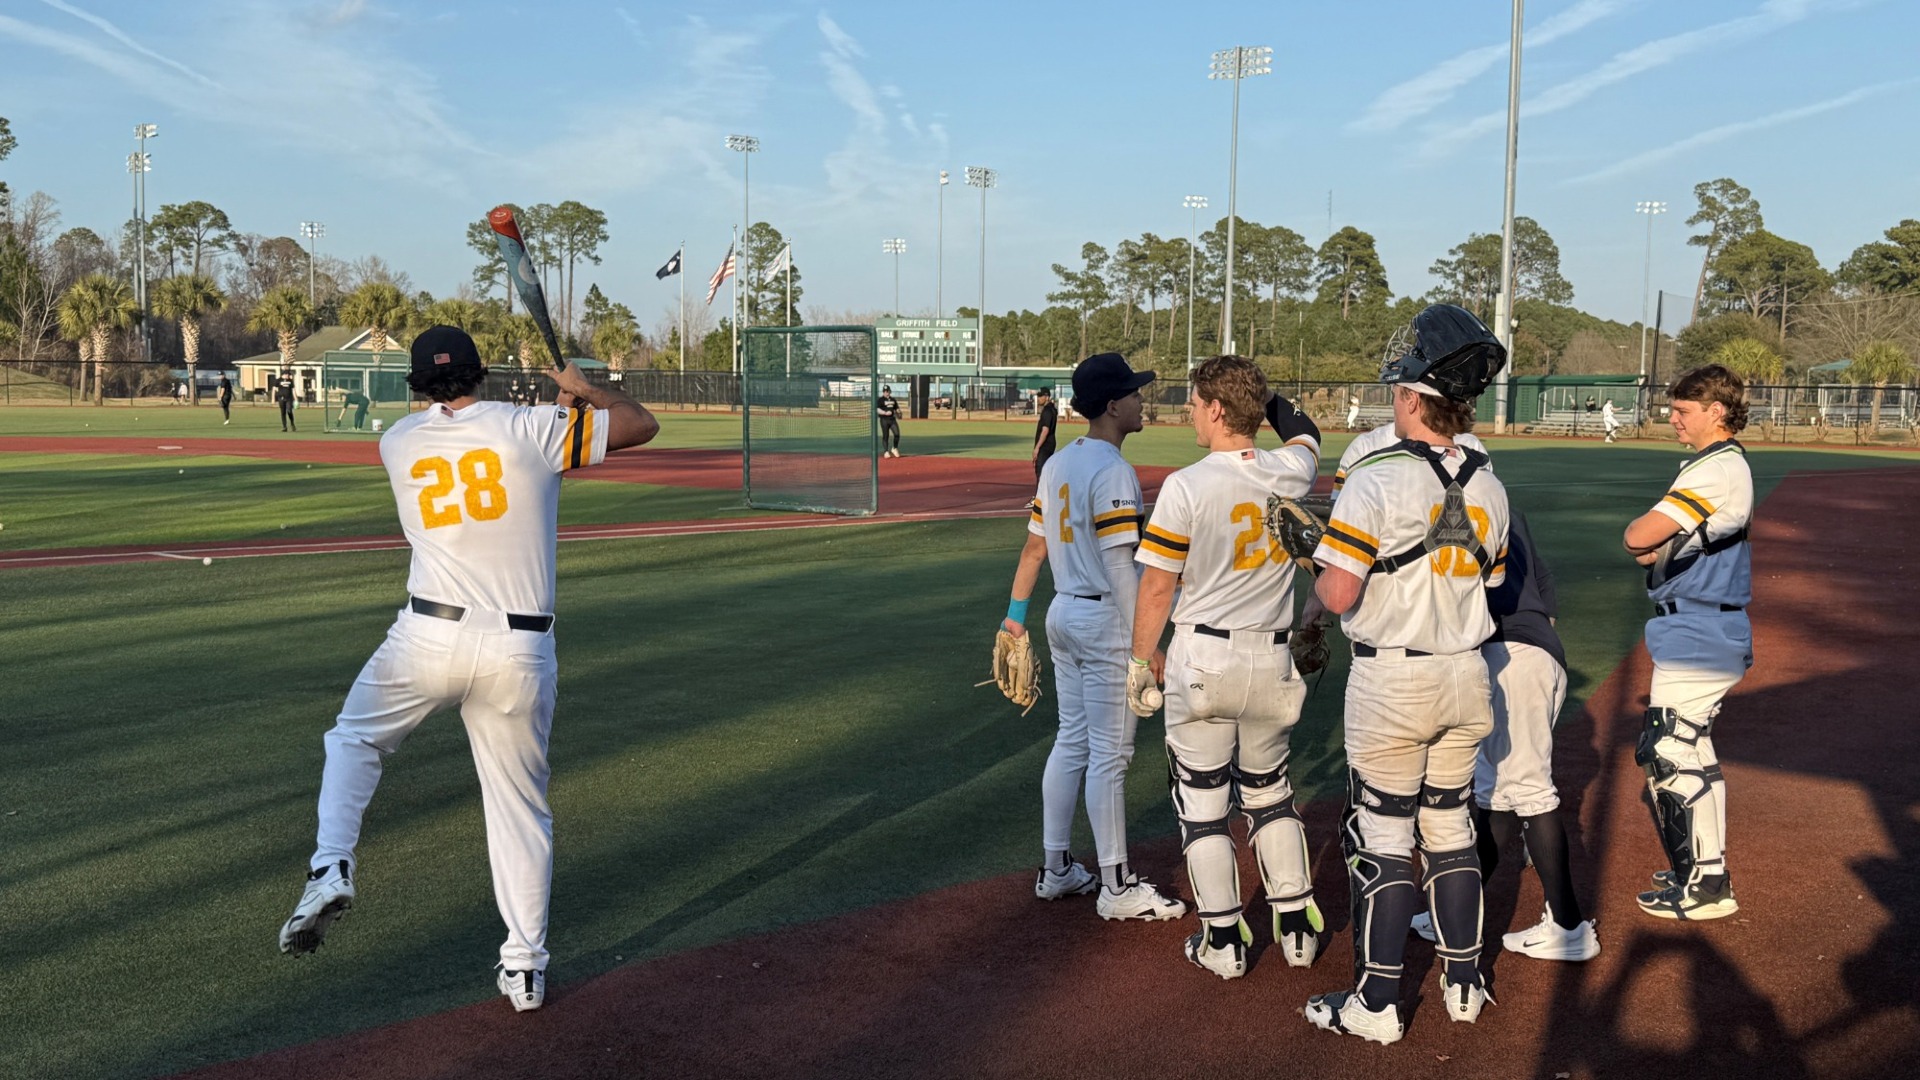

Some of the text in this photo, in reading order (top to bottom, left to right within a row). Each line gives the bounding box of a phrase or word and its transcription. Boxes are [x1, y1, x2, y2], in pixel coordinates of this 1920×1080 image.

[896, 319, 958, 327] GRIFFITH FIELD
[879, 345, 897, 353] GUEST
[880, 354, 896, 362] HOME
[410, 448, 508, 530] 28
